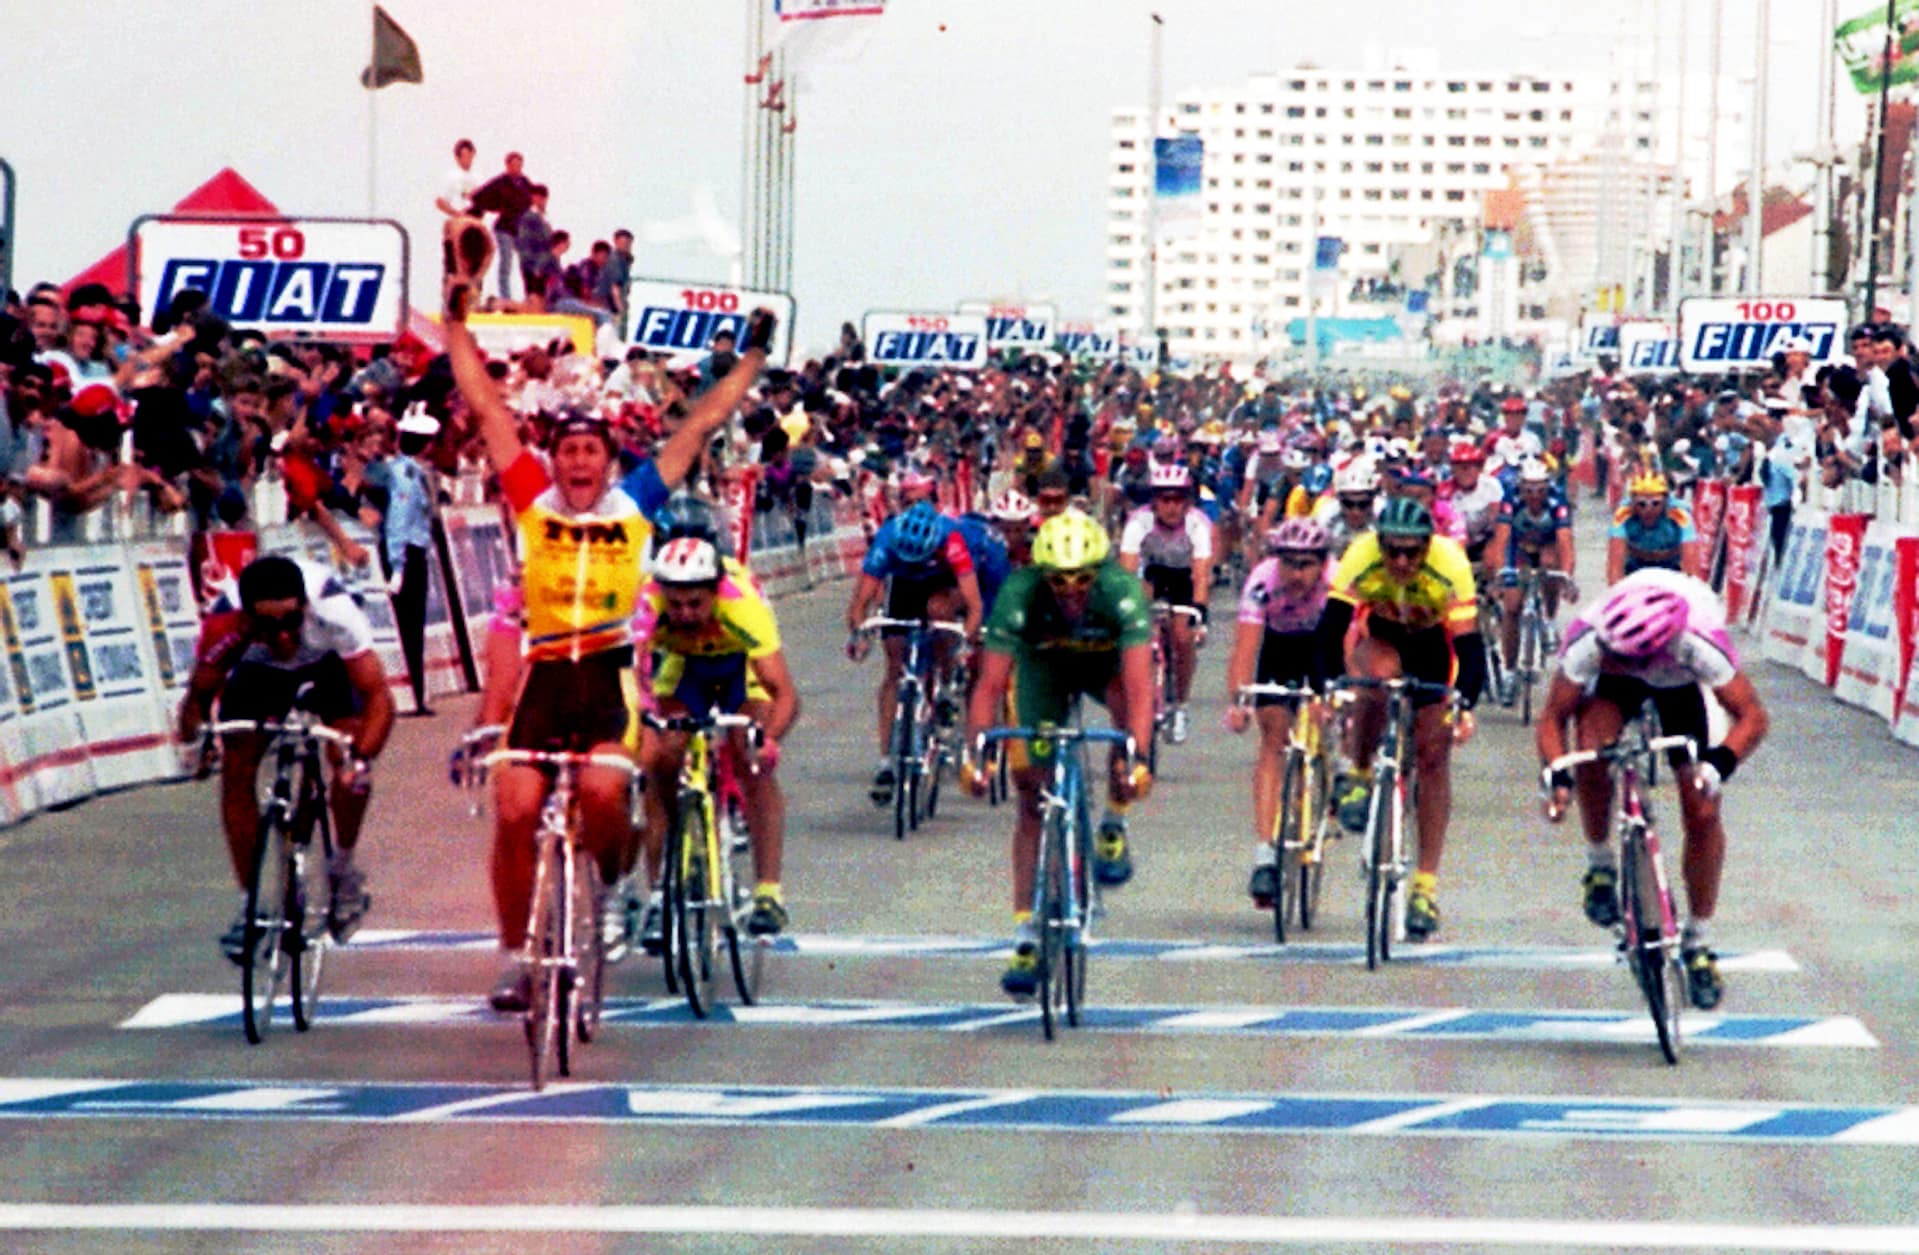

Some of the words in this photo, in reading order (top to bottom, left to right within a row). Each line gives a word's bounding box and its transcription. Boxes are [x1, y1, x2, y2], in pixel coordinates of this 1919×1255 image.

[238, 229, 305, 260] 50
[681, 290, 739, 313] 100
[1736, 303, 1796, 321] 100
[877, 332, 977, 360] FIAT
